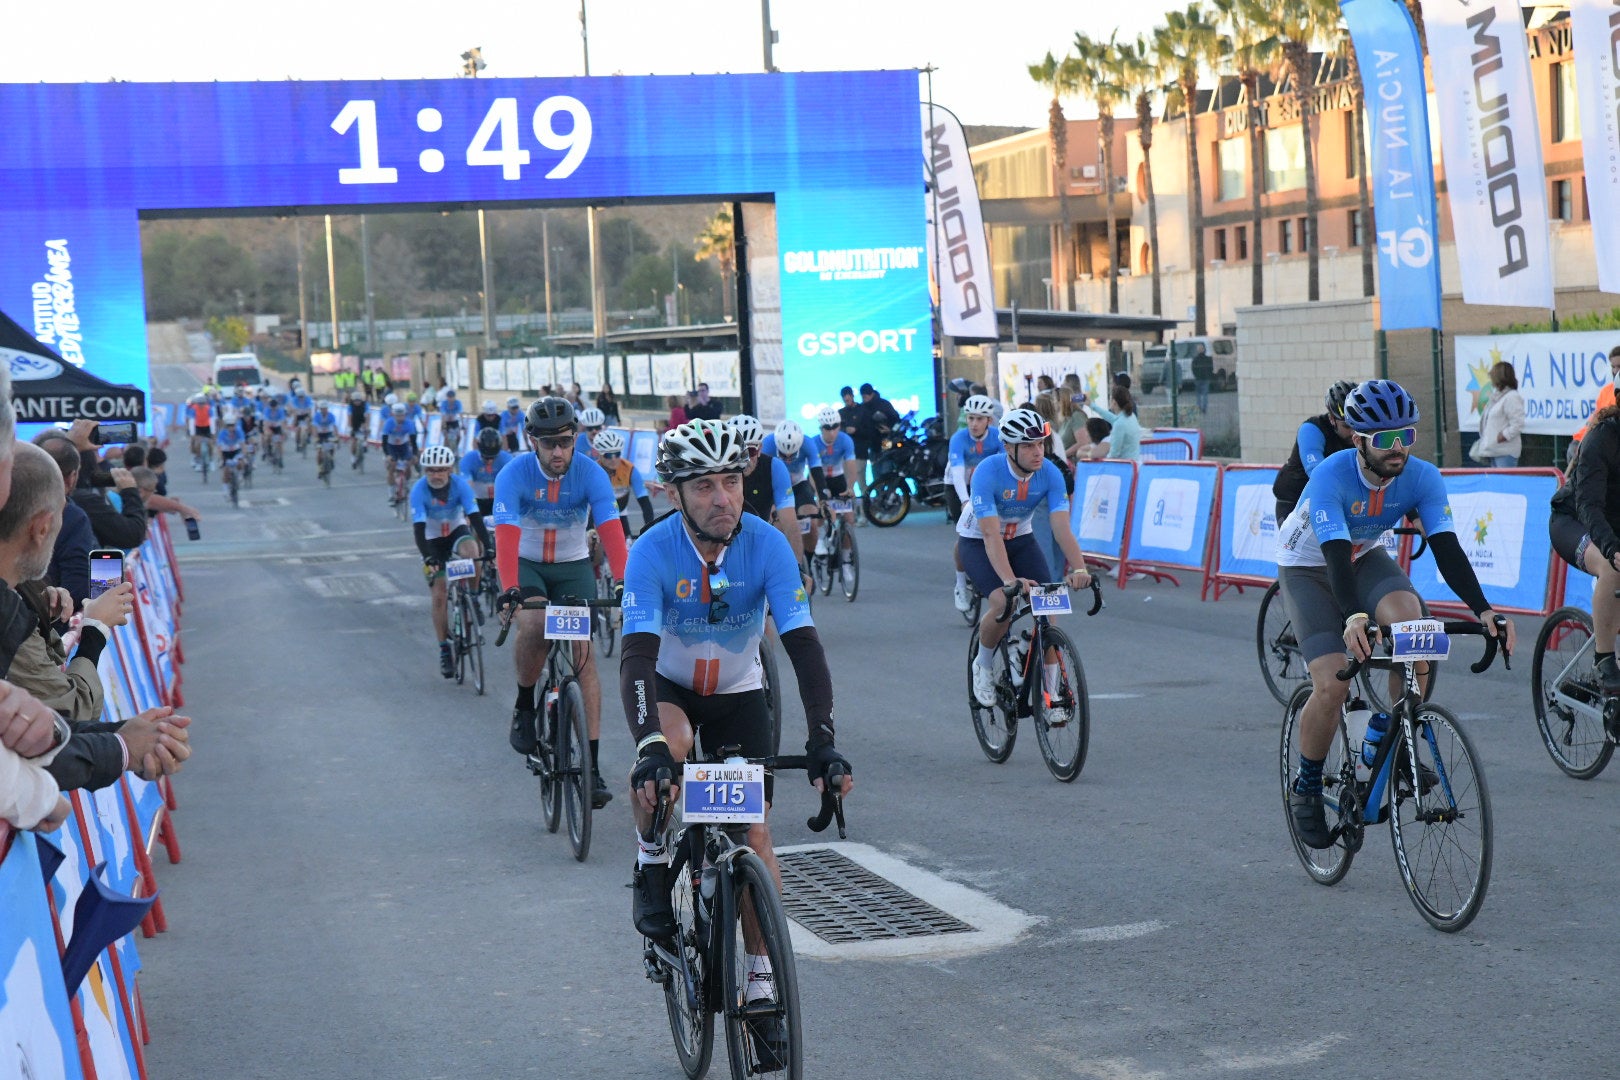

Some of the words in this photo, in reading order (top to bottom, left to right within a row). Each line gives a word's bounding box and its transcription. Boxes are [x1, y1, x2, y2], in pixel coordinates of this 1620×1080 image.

[797, 328, 918, 356] GSPORT
[1556, 399, 1578, 419] DEL
[1039, 596, 1061, 607] 789
[556, 616, 581, 630] 913
[683, 608, 757, 626] GENALITAT
[1409, 634, 1435, 649] 111
[714, 770, 722, 781] LA
[723, 768, 743, 781] NUCÍA
[704, 783, 746, 805] 115
